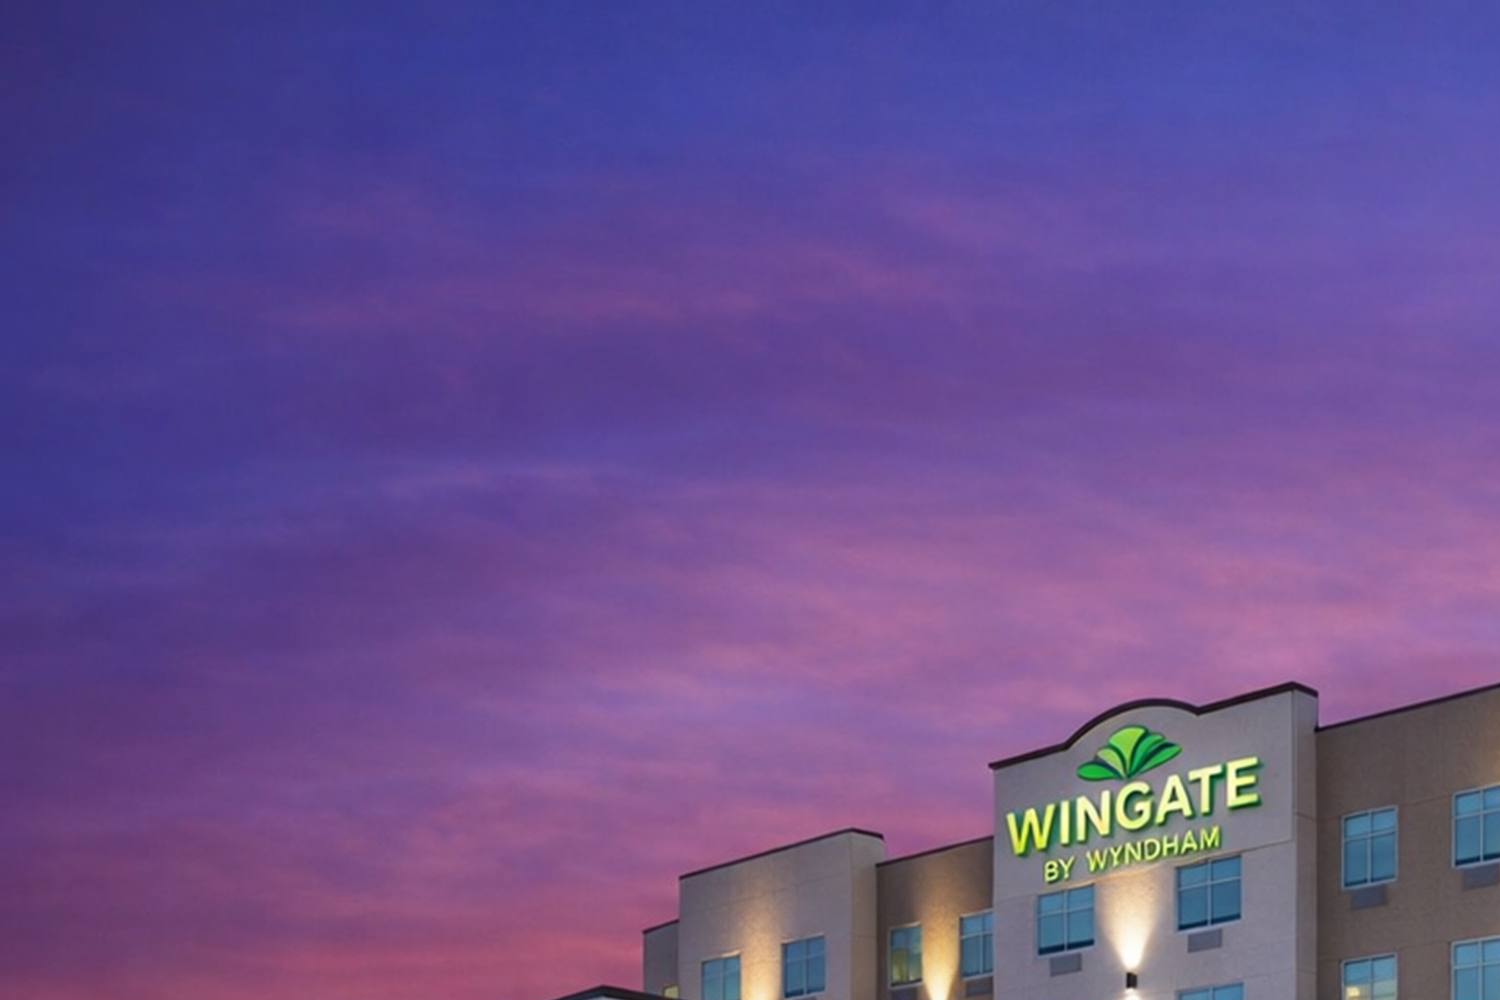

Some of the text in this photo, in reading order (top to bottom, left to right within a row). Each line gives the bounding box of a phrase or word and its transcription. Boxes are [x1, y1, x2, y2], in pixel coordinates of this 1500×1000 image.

[1006, 757, 1260, 855] WINGATE
[1044, 826, 1221, 883] BY WYNDHAM
